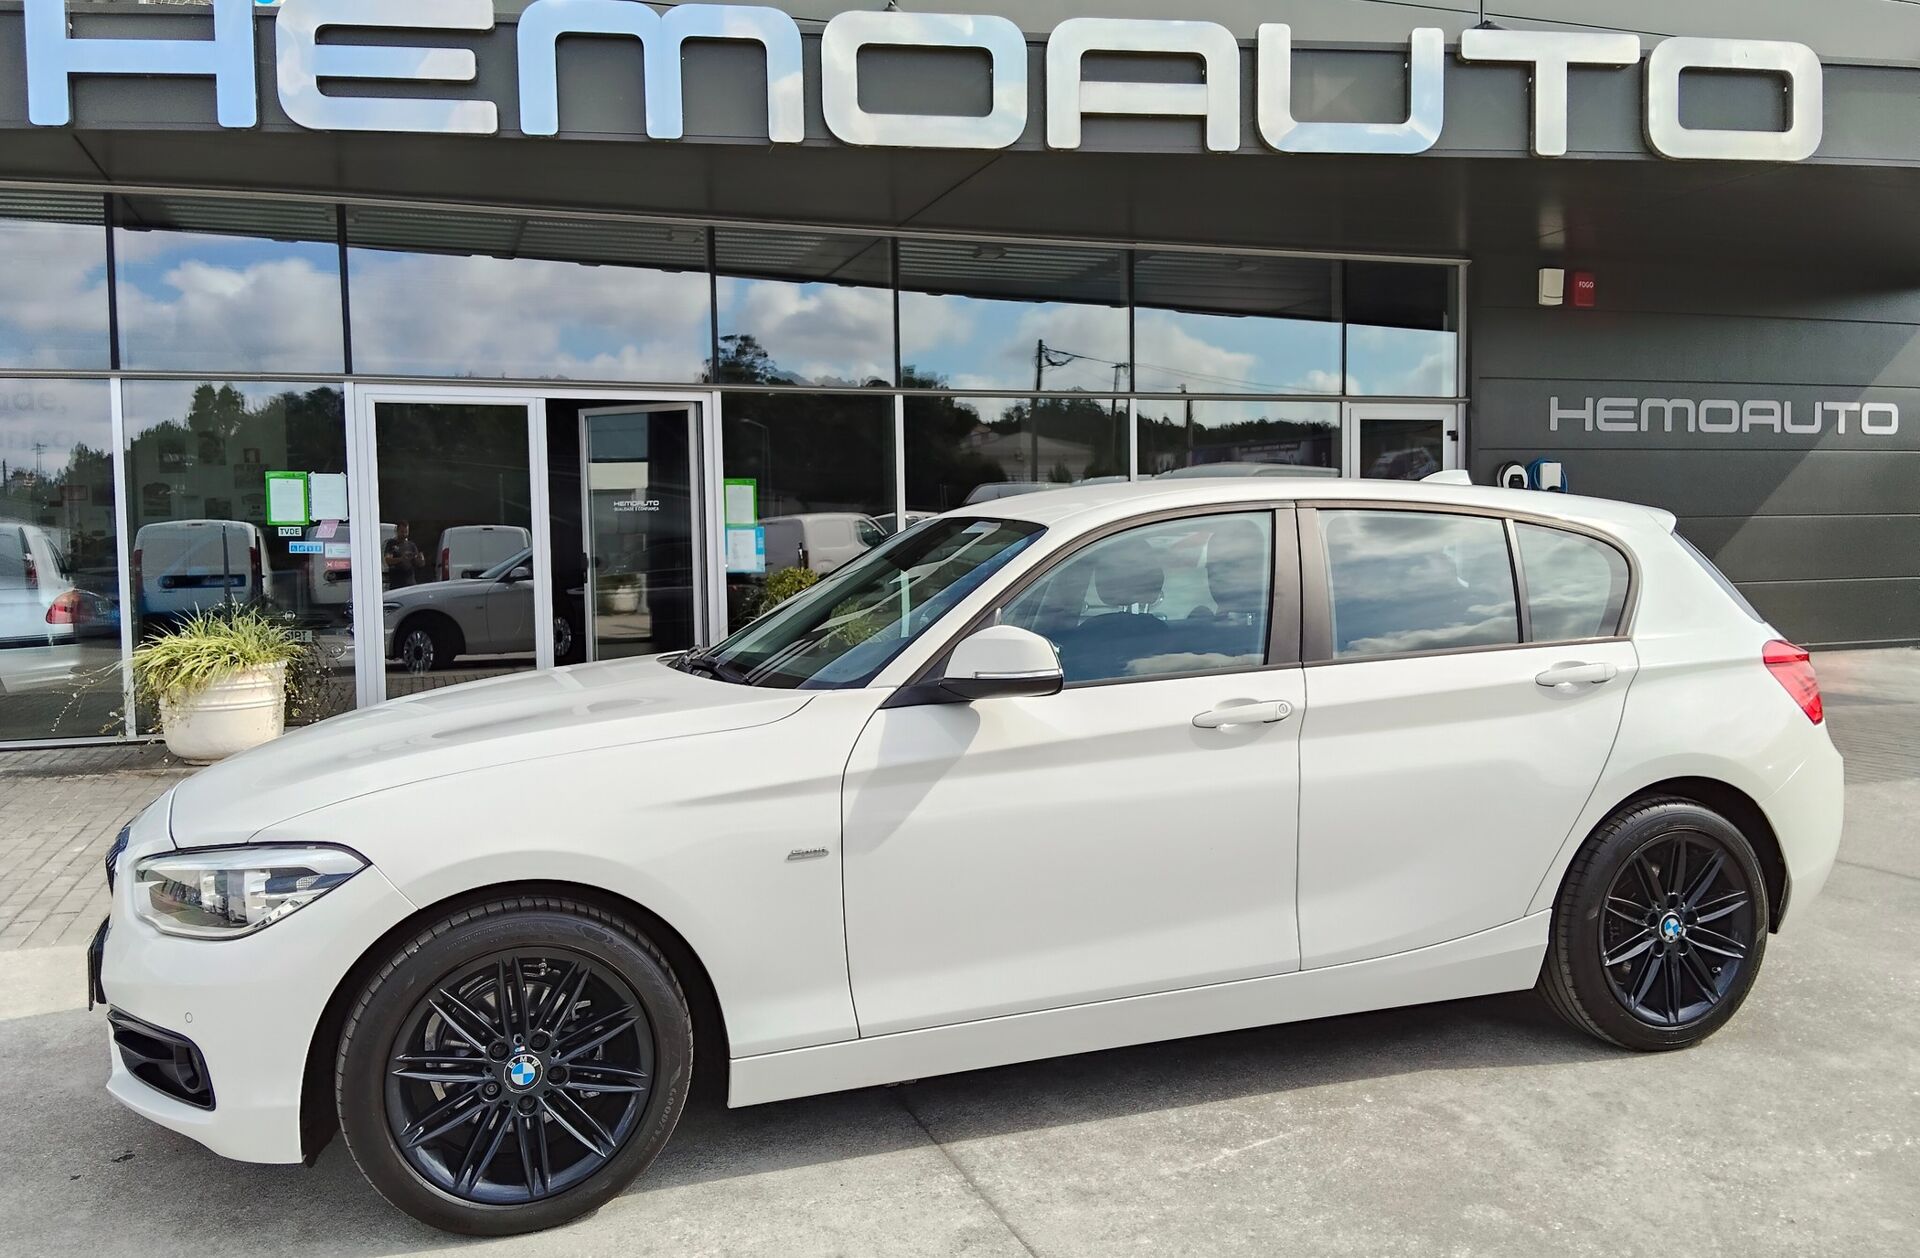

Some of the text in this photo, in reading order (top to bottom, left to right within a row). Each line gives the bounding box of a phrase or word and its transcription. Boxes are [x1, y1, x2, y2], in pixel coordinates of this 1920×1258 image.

[25, 0, 1824, 162] HEMOAUTO
[1578, 281, 1594, 289] FOGO
[1549, 396, 1899, 435] HEMOAUTO
